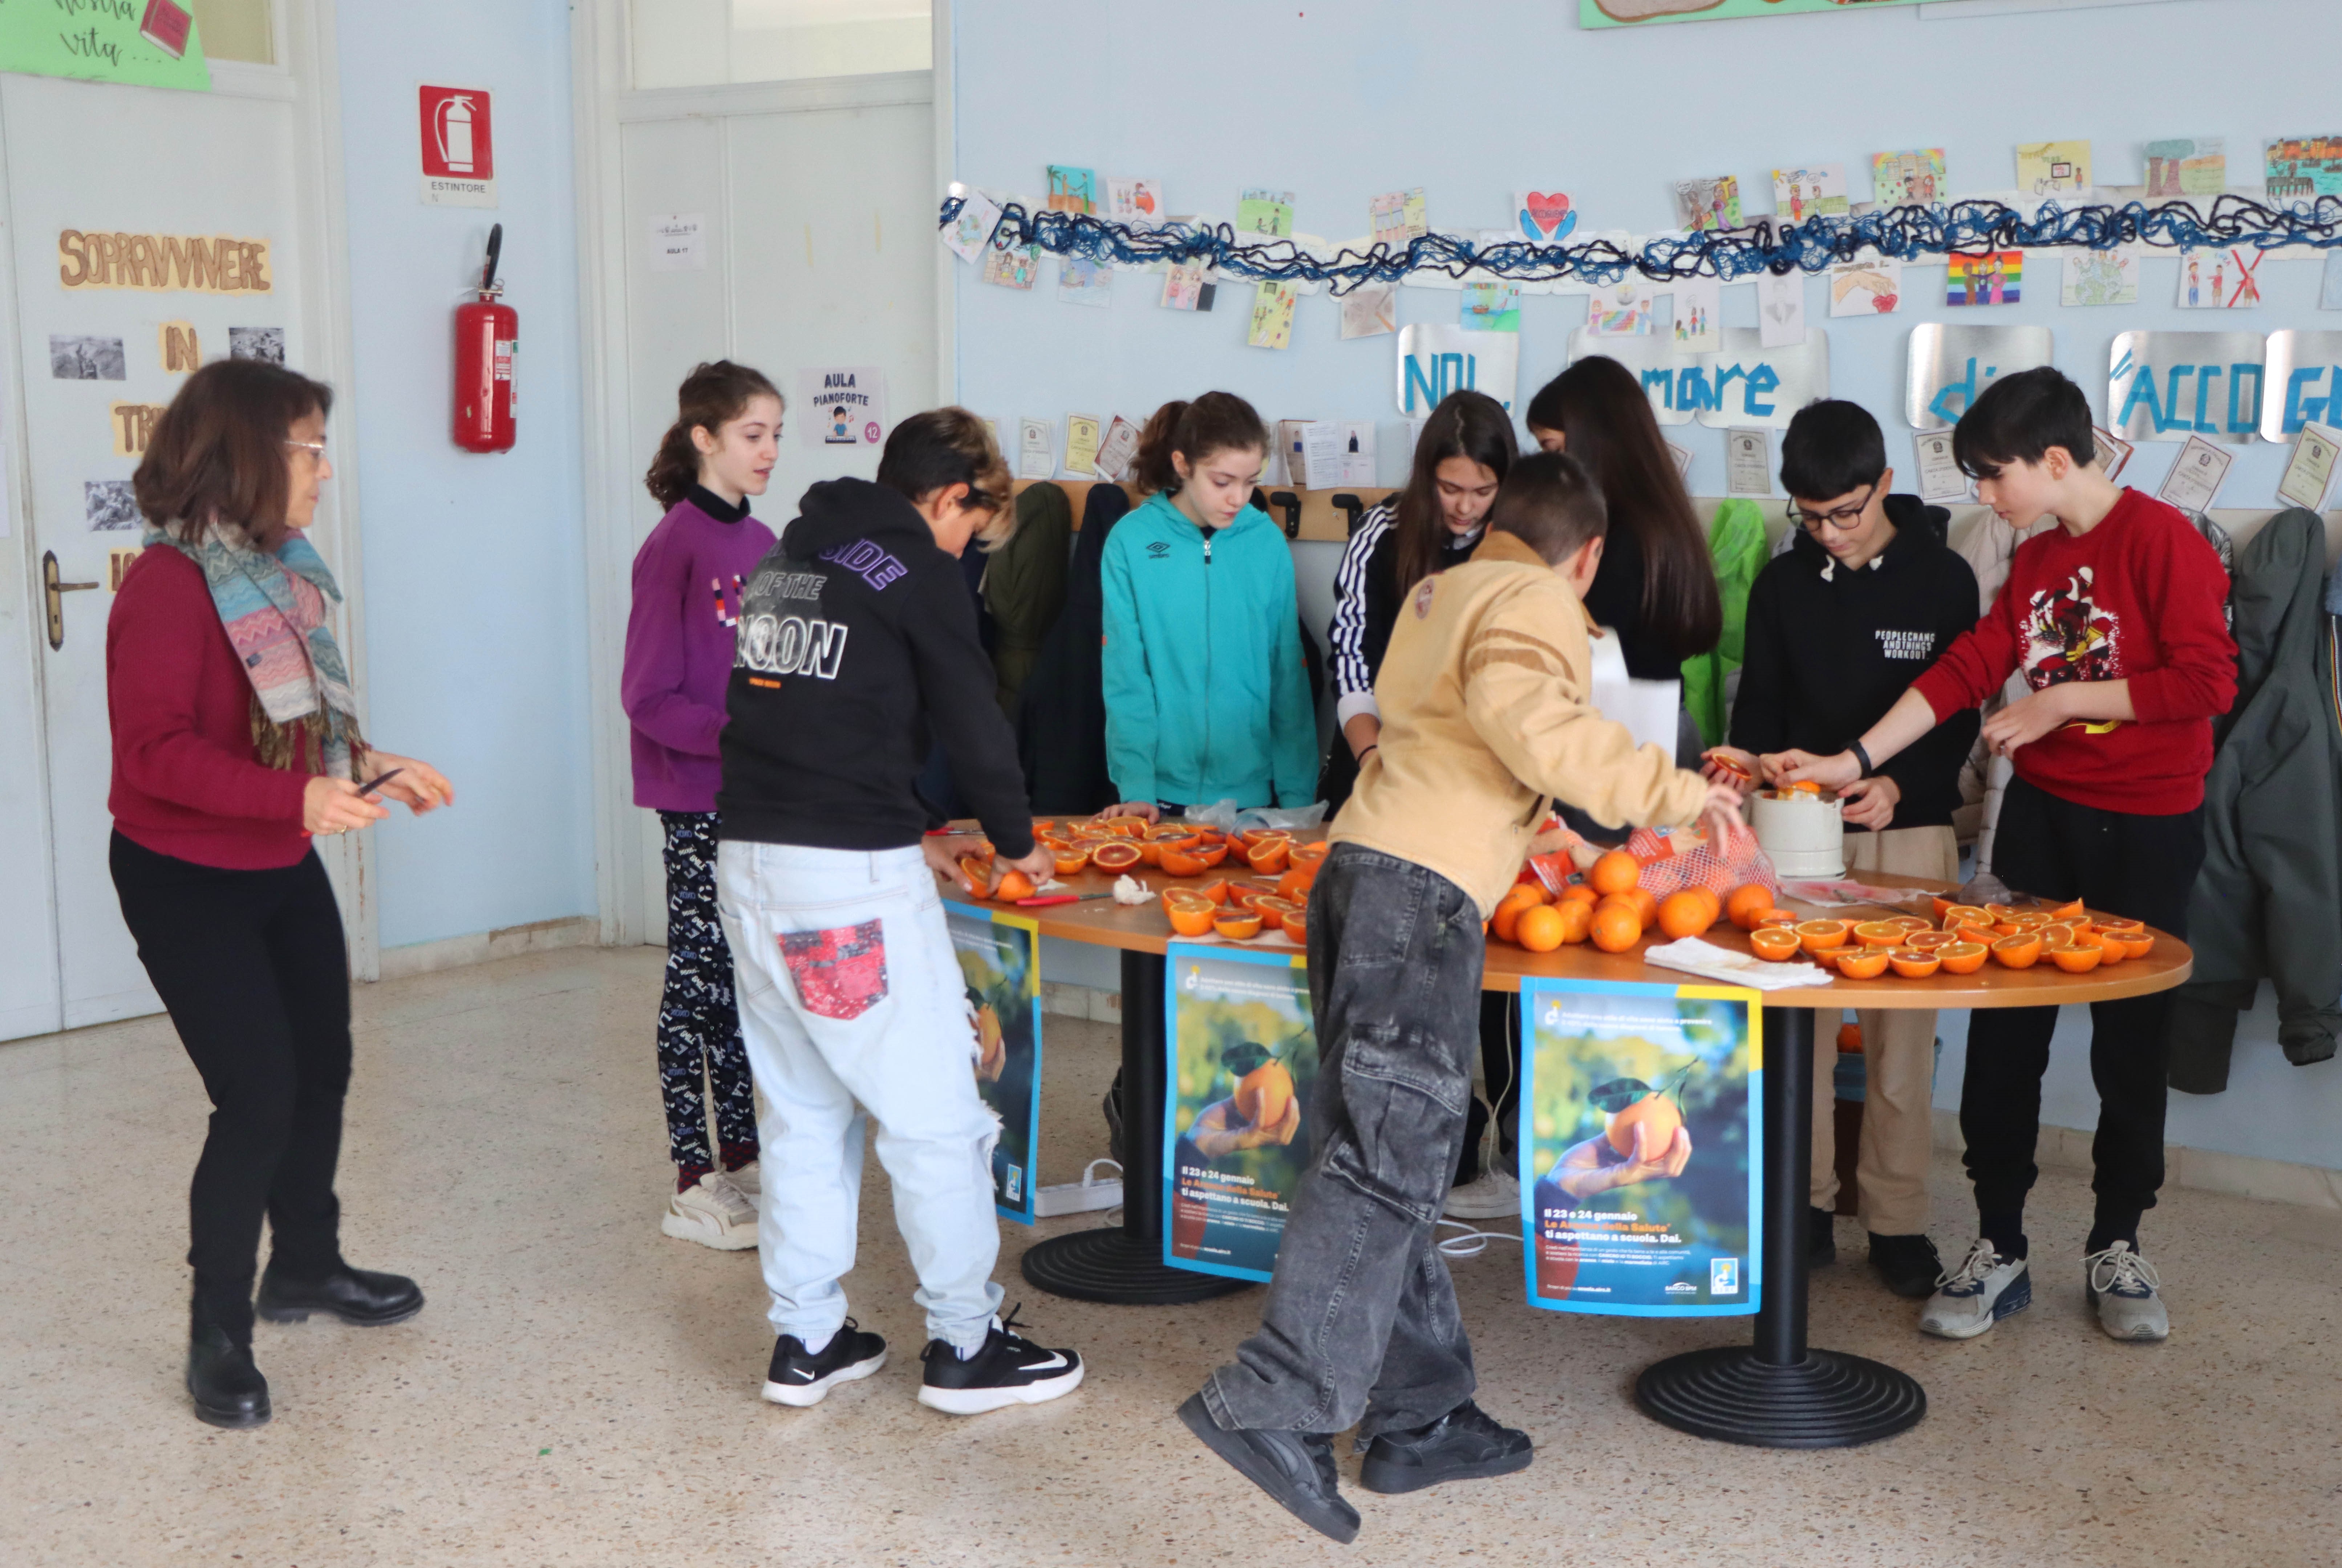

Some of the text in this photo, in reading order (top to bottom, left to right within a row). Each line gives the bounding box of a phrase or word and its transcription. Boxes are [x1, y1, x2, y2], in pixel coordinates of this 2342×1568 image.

[60, 27, 123, 66] vita
[432, 182, 486, 193] ESTINTORE
[166, 326, 198, 371] IN
[824, 373, 856, 389] AULA
[814, 393, 869, 407] PIANOFORTE
[868, 427, 878, 438] 12
[755, 571, 828, 601] OF THE
[1182, 1166, 1188, 1175] Il
[1190, 1167, 1200, 1177] 23
[1208, 1170, 1219, 1179] 24
[1220, 1173, 1255, 1185] gennaio
[1182, 1177, 1192, 1186] Le
[1182, 1187, 1188, 1196] ti
[1190, 1189, 1232, 1203] aspettano
[1240, 1198, 1271, 1209] scuola.
[1544, 1209, 1552, 1218] Il
[1553, 1210, 1568, 1218] 23
[1578, 1210, 1592, 1219] 24
[1594, 1212, 1638, 1221] gennaio
[1545, 1220, 1558, 1228] Le
[1601, 1222, 1629, 1231] della
[1545, 1230, 1554, 1238] ti
[1555, 1231, 1609, 1241] aspettano
[1620, 1233, 1659, 1243] scuola.
[1660, 1234, 1682, 1243] Dai.
